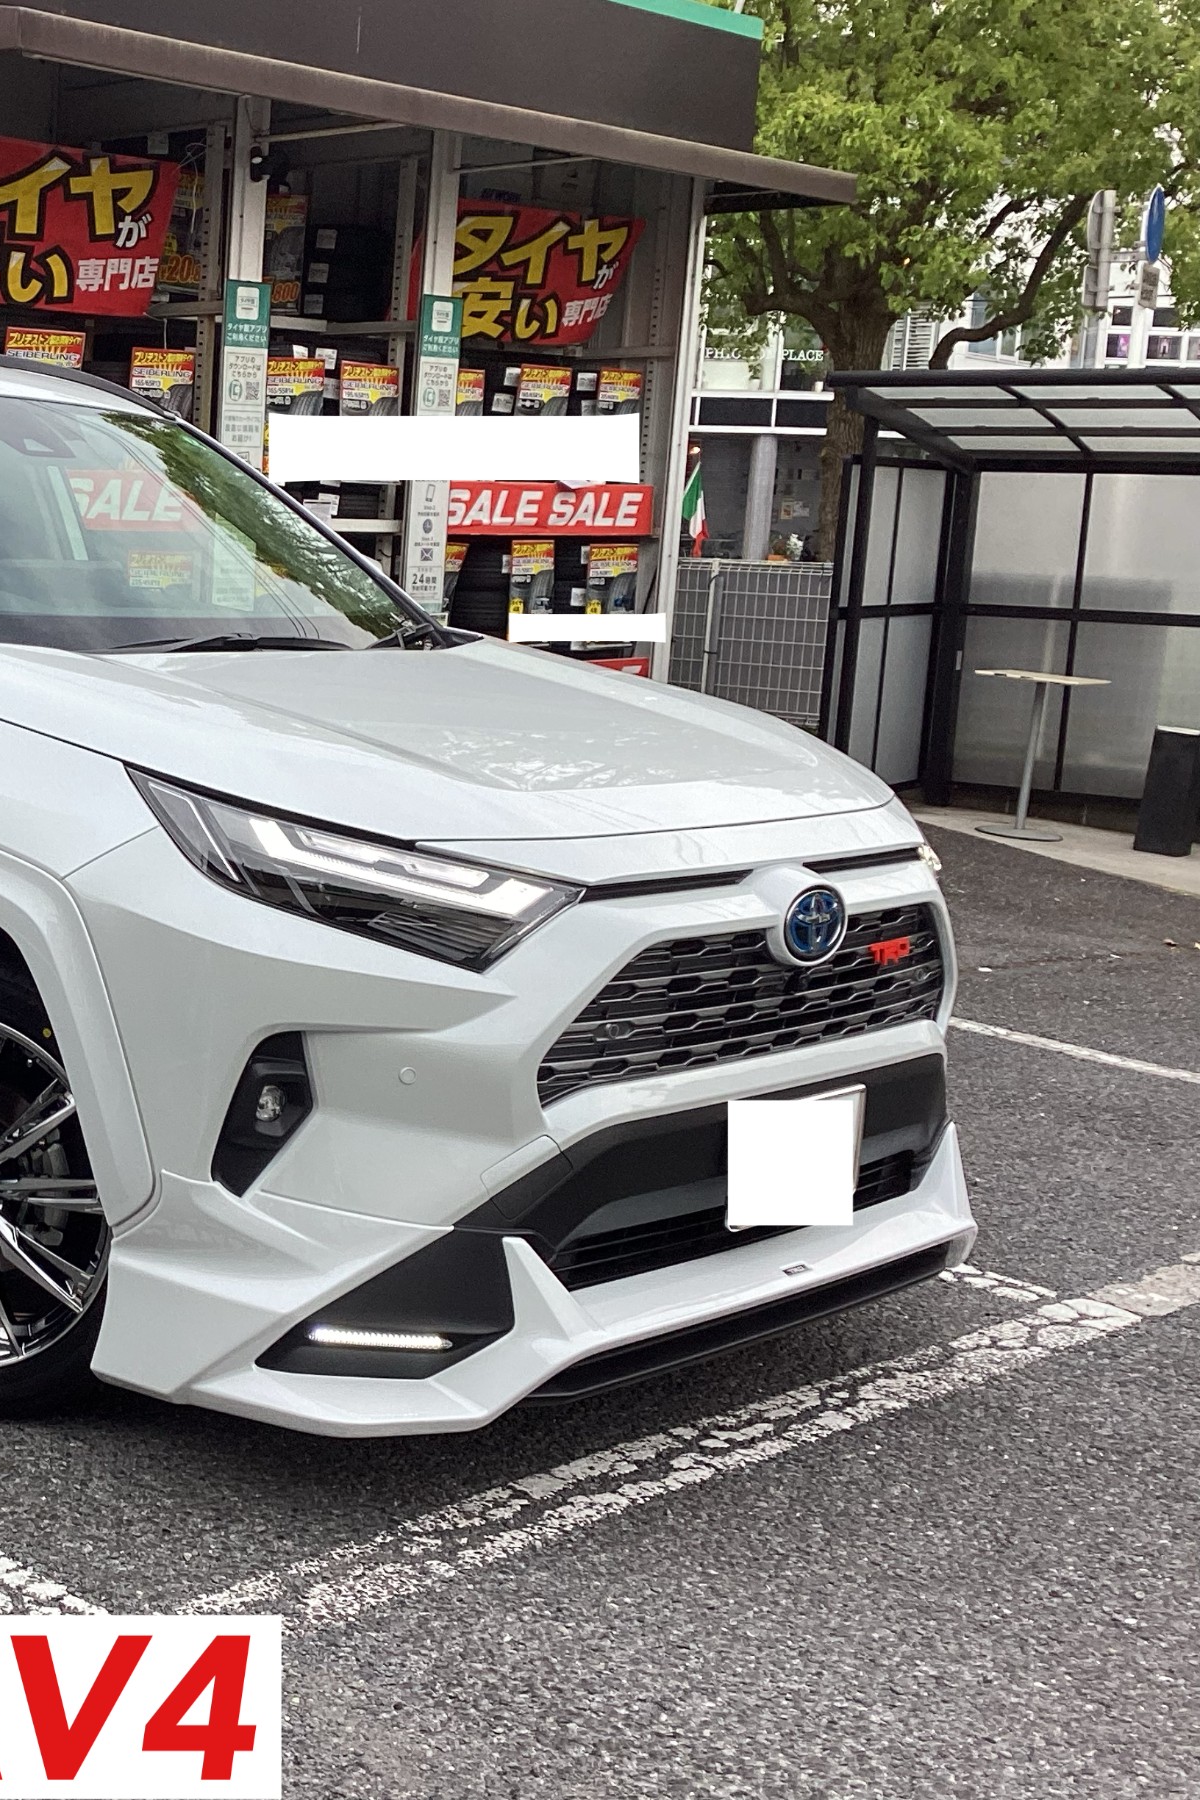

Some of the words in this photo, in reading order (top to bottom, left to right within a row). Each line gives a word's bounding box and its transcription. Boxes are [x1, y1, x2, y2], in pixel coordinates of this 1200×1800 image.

[75, 256, 159, 291] 専門店
[561, 293, 614, 327] 専門店
[7, 349, 78, 362] SEIBERLING
[782, 349, 824, 361] PLACE
[133, 367, 192, 378] SEIBERLING
[447, 489, 543, 526] SALE
[547, 491, 644, 527] SALE
[870, 936, 910, 966] TRD
